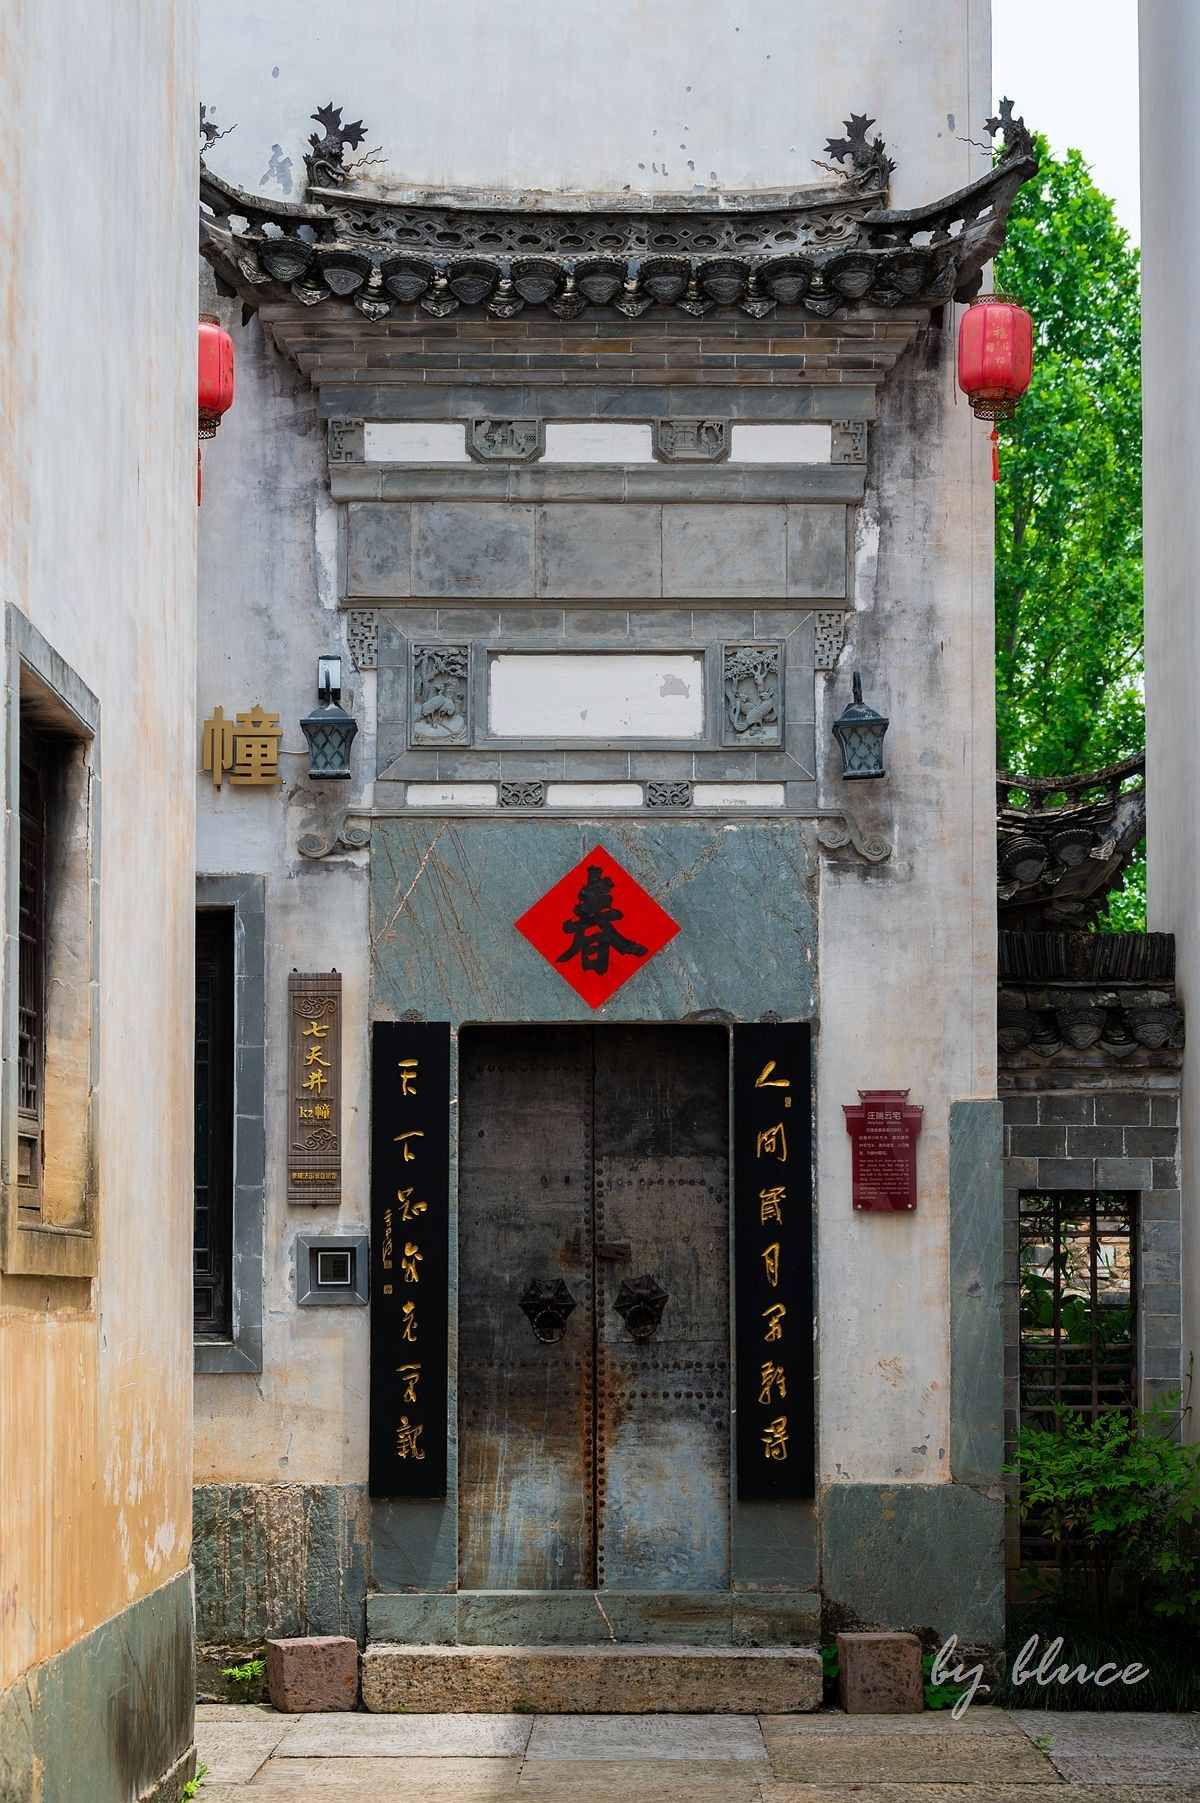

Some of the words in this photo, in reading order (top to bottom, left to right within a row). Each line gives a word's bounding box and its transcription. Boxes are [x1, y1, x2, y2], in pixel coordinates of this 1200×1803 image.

[203, 705, 283, 785] 幢
[555, 865, 649, 976] 春
[302, 1021, 331, 1095] 七天井
